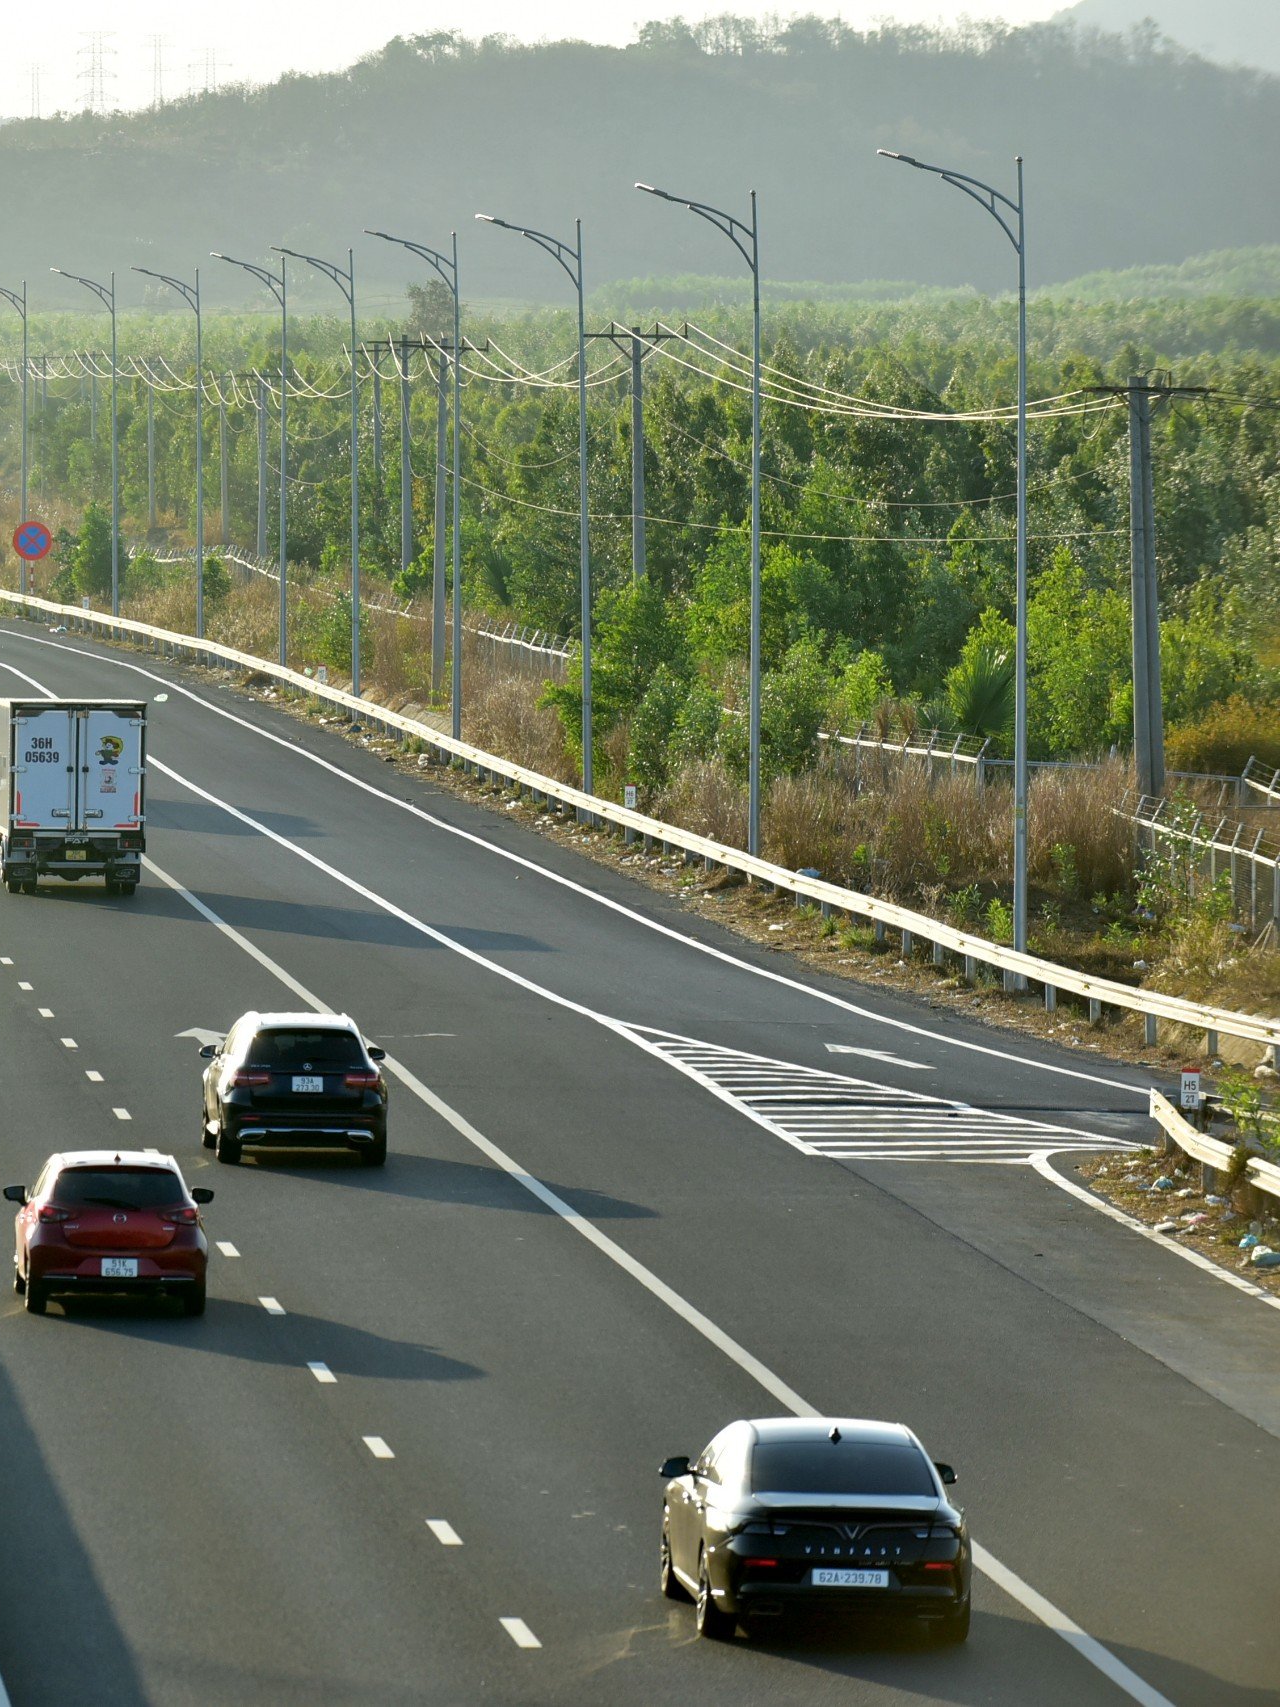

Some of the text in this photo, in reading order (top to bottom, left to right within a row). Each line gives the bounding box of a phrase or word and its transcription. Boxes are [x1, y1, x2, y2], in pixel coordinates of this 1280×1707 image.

[31, 737, 53, 749] 36H
[25, 751, 60, 763] 05639
[301, 1077, 314, 1085] 93A
[1184, 1080, 1197, 1091] H5
[1185, 1094, 1195, 1104] 27
[111, 1259, 128, 1268] 51K
[805, 1545, 901, 1556] VINFAST
